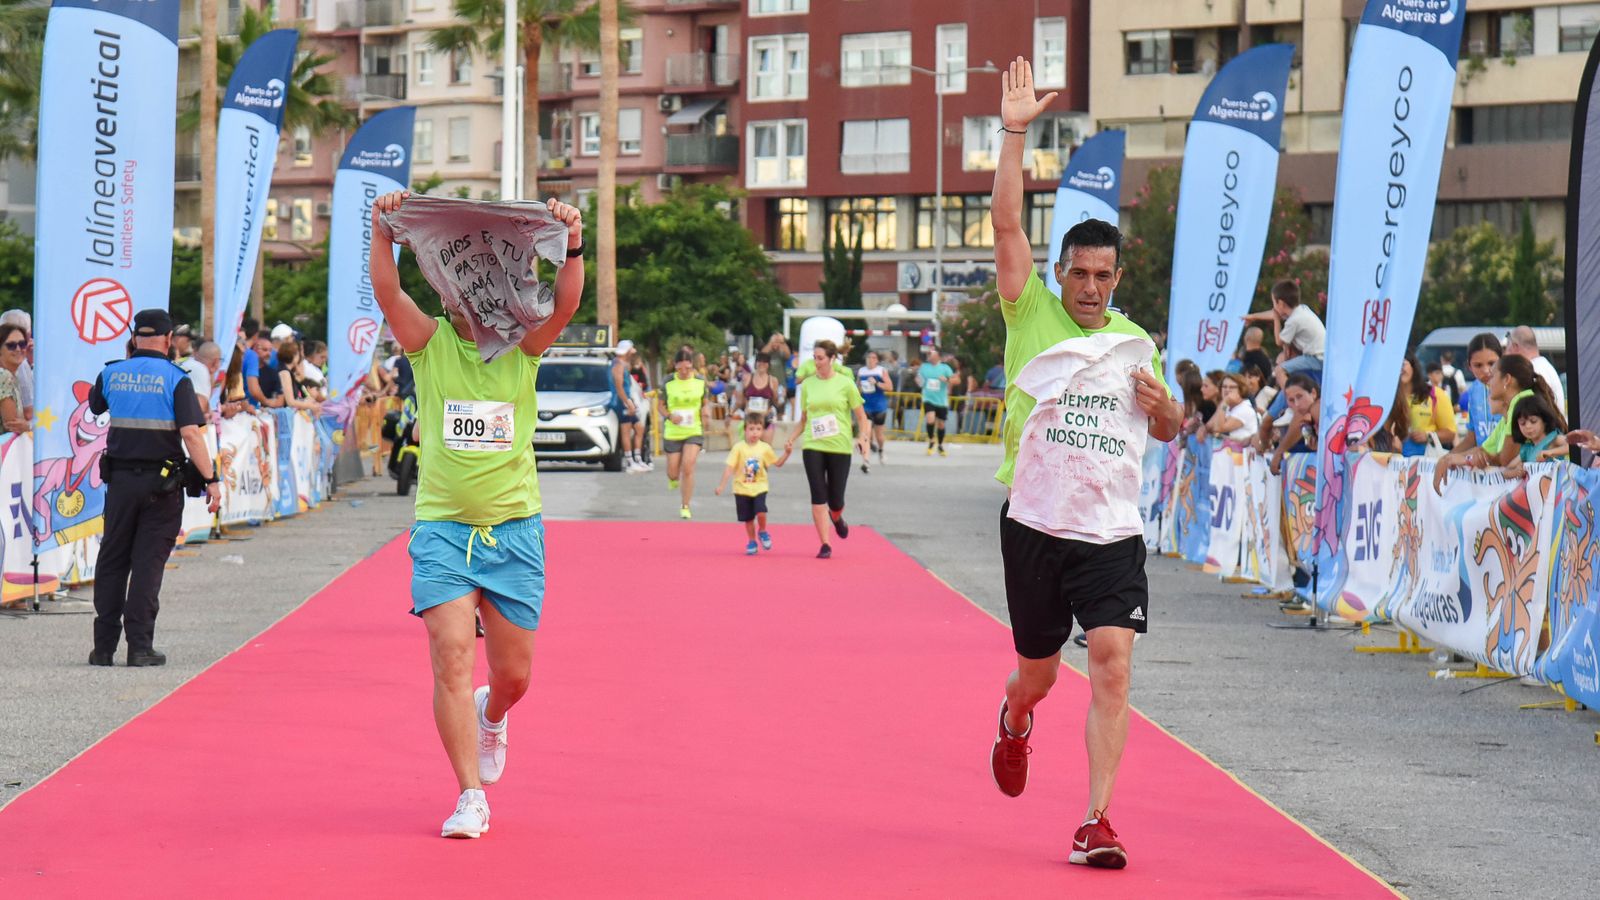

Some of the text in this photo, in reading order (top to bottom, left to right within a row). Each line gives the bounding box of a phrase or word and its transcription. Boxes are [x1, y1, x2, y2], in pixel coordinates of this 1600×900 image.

[1426, 0, 1439, 9] de
[244, 85, 265, 96] Puerto
[234, 92, 273, 108] Algeciras
[1221, 97, 1260, 110] Puerto de
[1208, 104, 1260, 120] Algeciras
[86, 28, 122, 267] lalíneavertical
[360, 150, 380, 159] Puerto
[351, 156, 391, 167] Algeciras
[1069, 175, 1103, 189] Algeciras
[1077, 170, 1096, 180] Puerto
[1375, 65, 1414, 290] Sergeyco
[120, 160, 138, 270] Limitless Safety
[1208, 150, 1240, 313] Sergeyco
[440, 234, 472, 266] DIOS
[502, 239, 524, 262] TU
[454, 252, 498, 280] PASTO
[110, 372, 164, 384] POLICIA
[110, 383, 164, 394] PORTUARIA
[453, 418, 485, 437] 809
[1064, 412, 1098, 428] CON
[1046, 427, 1126, 457] NOSOTROS
